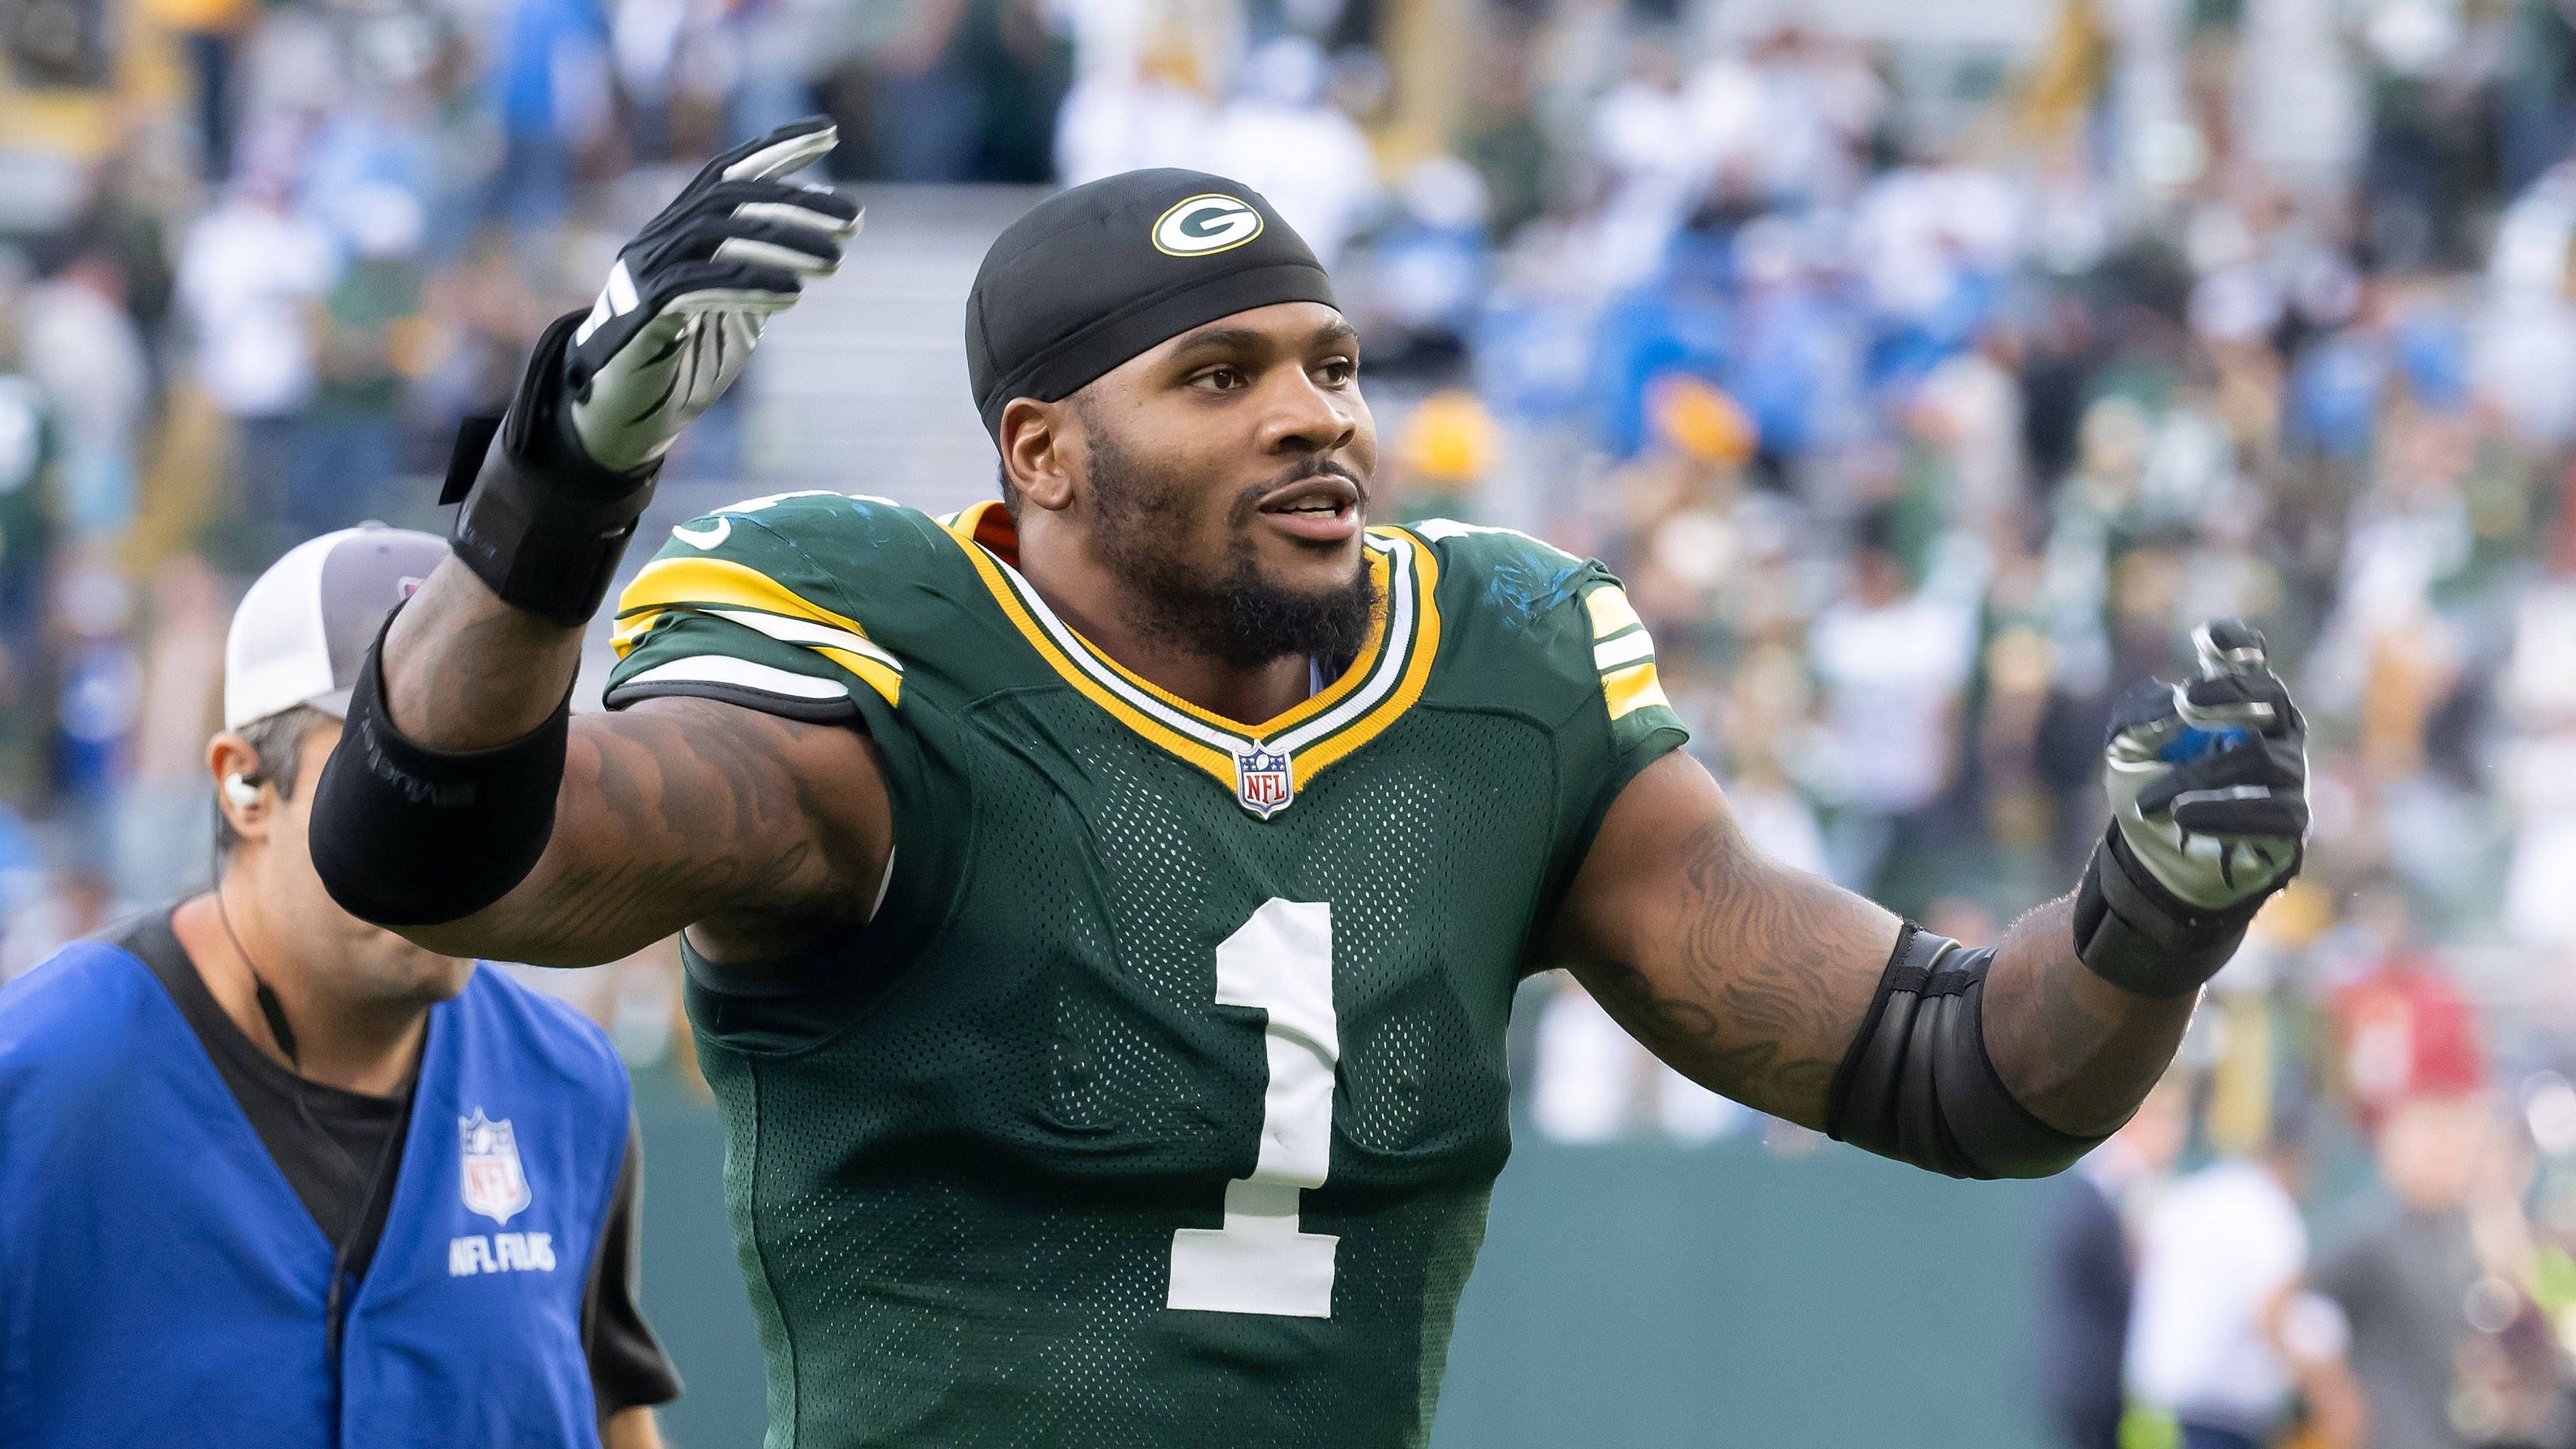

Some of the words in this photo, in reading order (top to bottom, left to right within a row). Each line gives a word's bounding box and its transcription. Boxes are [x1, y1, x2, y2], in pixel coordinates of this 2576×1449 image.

[1159, 197, 1257, 250] G
[1246, 775, 1285, 804] NFL
[1166, 896, 1340, 1319] 1
[449, 1235, 498, 1277] NFL
